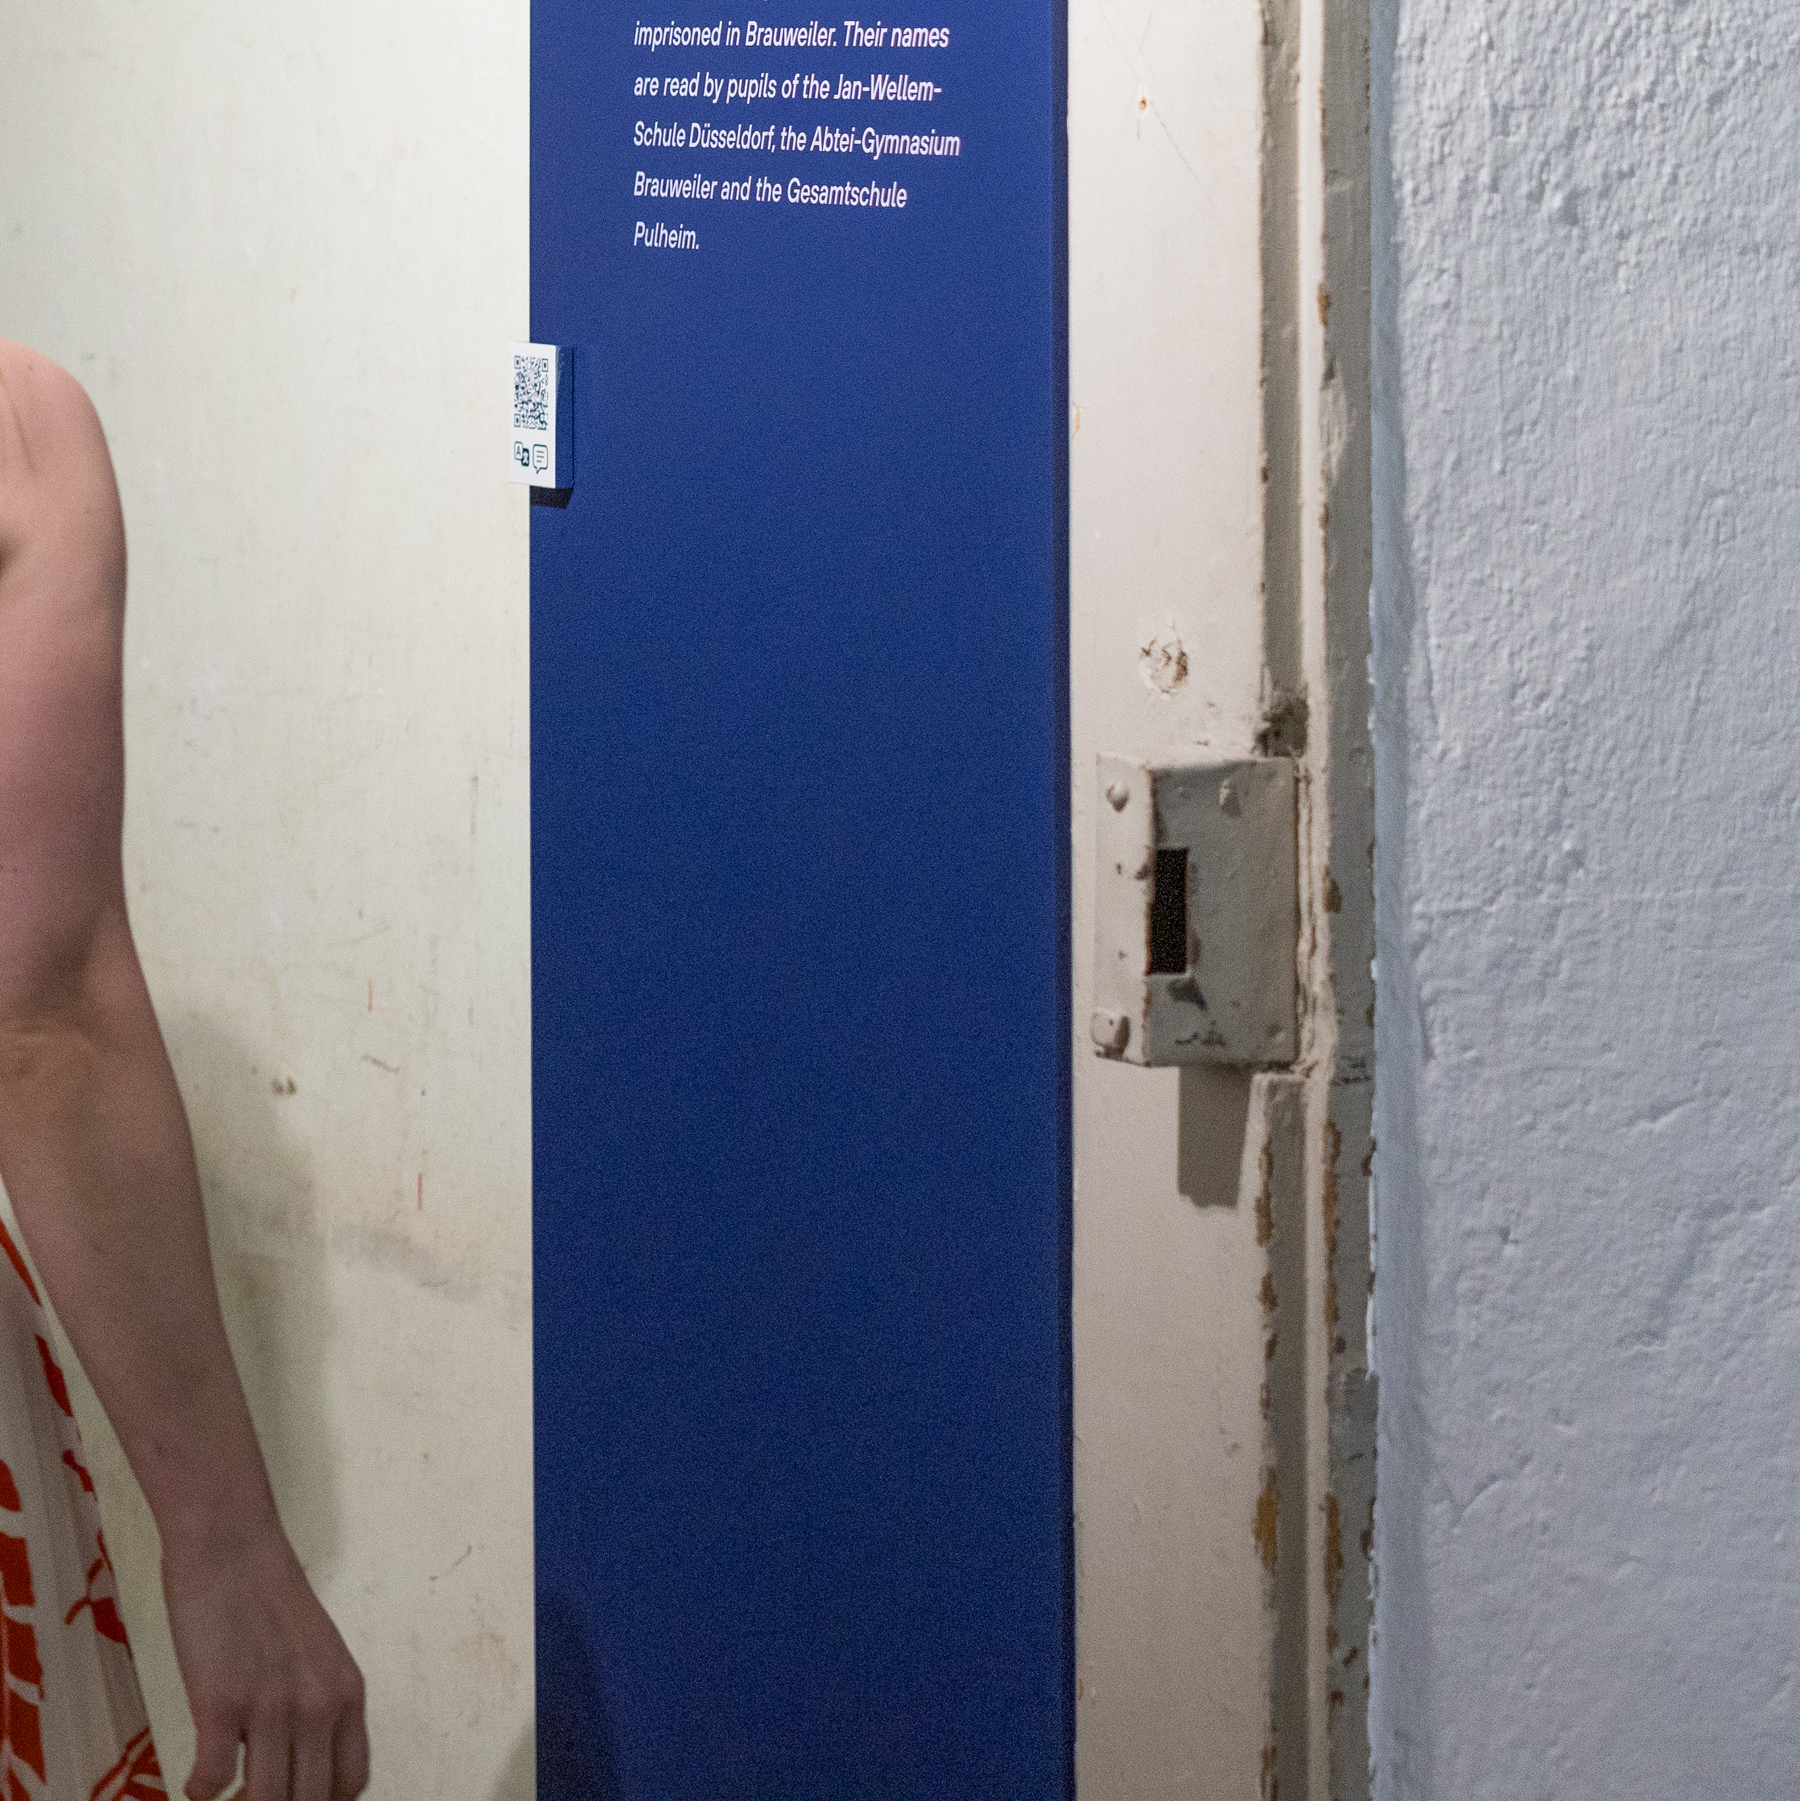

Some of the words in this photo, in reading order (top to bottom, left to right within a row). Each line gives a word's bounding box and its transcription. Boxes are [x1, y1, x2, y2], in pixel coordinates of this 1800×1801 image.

[633, 20, 723, 52] imprisoned
[725, 20, 741, 46] in
[744, 20, 837, 47] Brauweiler.
[843, 20, 888, 48] Their
[890, 27, 951, 48] names
[633, 76, 660, 96] are
[663, 71, 701, 97] read
[703, 71, 725, 104] by
[725, 72, 778, 104] pupils
[781, 73, 801, 99] of
[802, 73, 831, 100] the
[833, 73, 942, 101] Jan-Wellem-
[633, 120, 686, 148] Schule
[688, 122, 776, 153] Düsseldorf,
[780, 125, 807, 152] the
[809, 125, 961, 161] Abtei-Gymnasium
[633, 171, 718, 200] Brauweiler
[720, 175, 752, 201] and
[755, 176, 783, 203] the
[787, 177, 908, 208] Gesamtschule
[633, 221, 700, 249] Pulheim.
